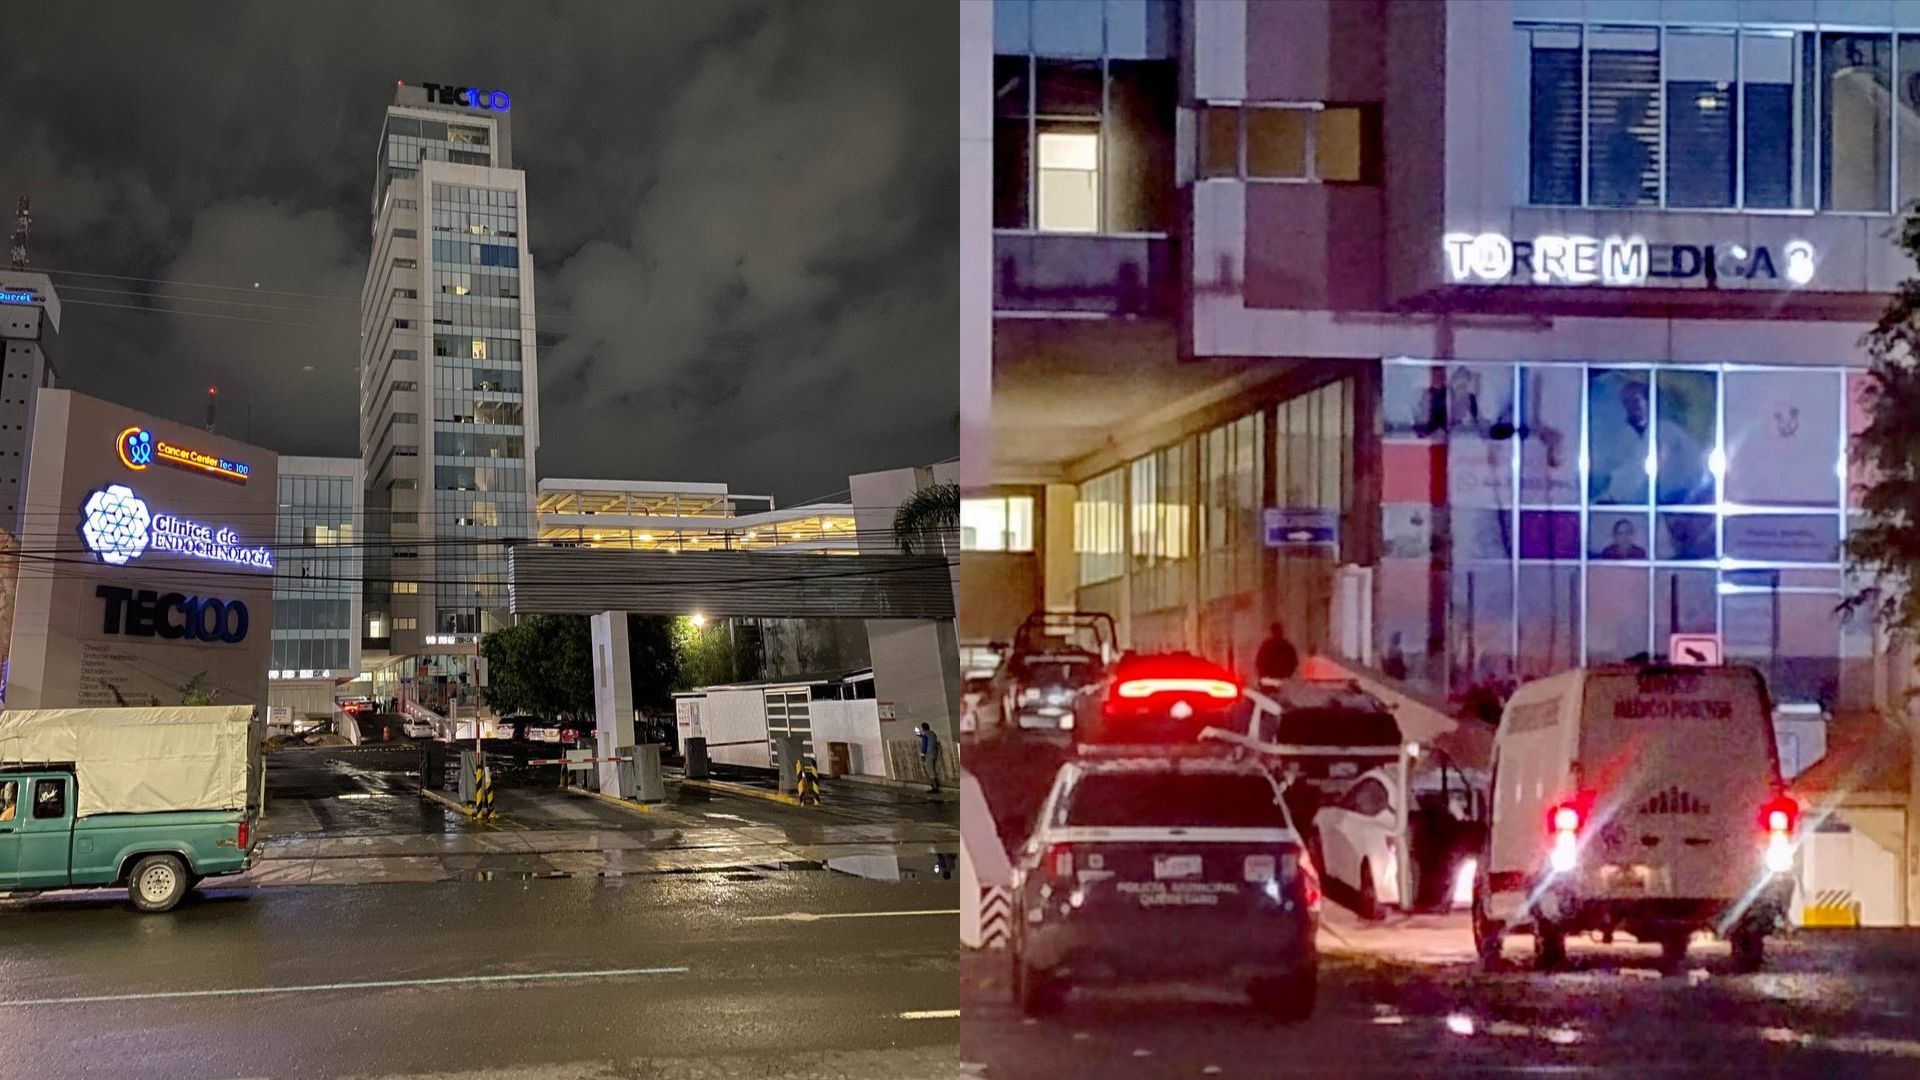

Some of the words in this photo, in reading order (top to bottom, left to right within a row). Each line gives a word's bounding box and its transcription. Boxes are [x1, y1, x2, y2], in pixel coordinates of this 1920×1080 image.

[423, 82, 510, 112] TEC100
[1445, 234, 1599, 282] TORRE
[157, 442, 190, 460] Cancer
[190, 451, 218, 467] Center
[219, 459, 233, 471] Tec
[236, 463, 248, 475] 100
[216, 527, 239, 546] de
[96, 585, 248, 643] TEC100
